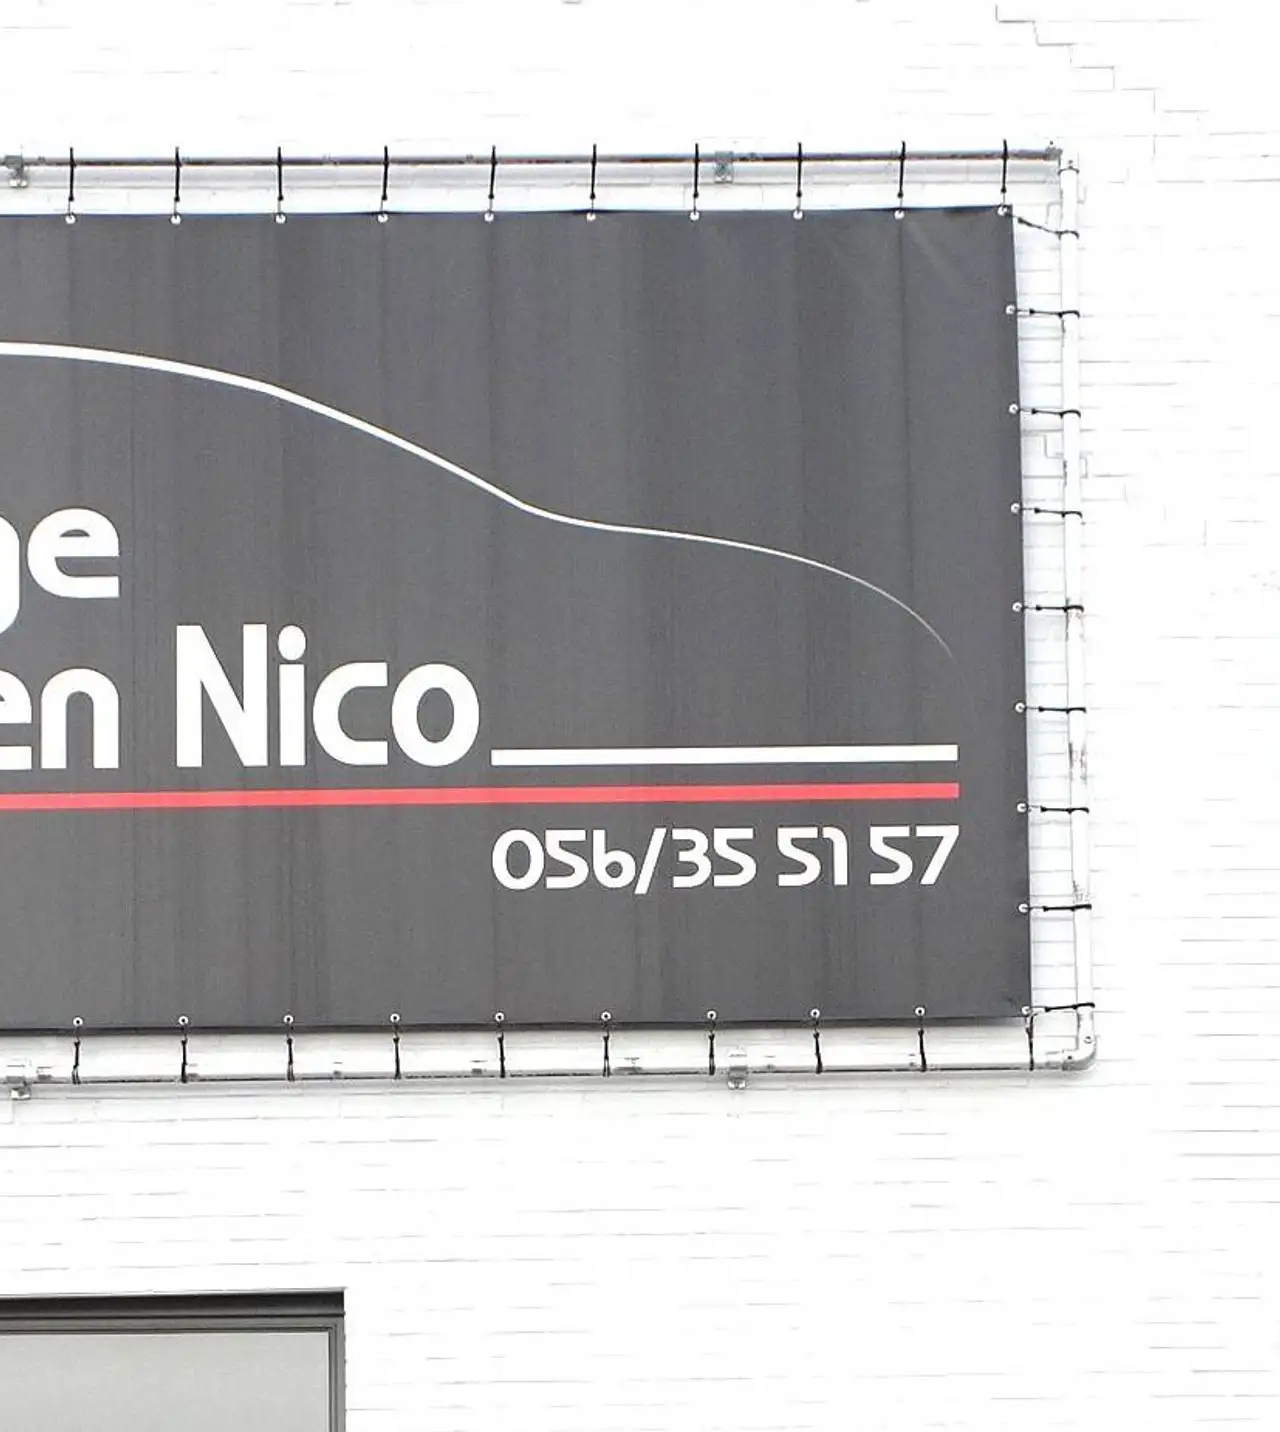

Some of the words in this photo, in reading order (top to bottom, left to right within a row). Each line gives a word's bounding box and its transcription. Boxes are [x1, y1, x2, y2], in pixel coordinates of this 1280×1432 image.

[175, 623, 480, 770] Nico
[492, 827, 757, 895] 056/35
[777, 826, 848, 887] 51
[869, 824, 960, 886] 57
